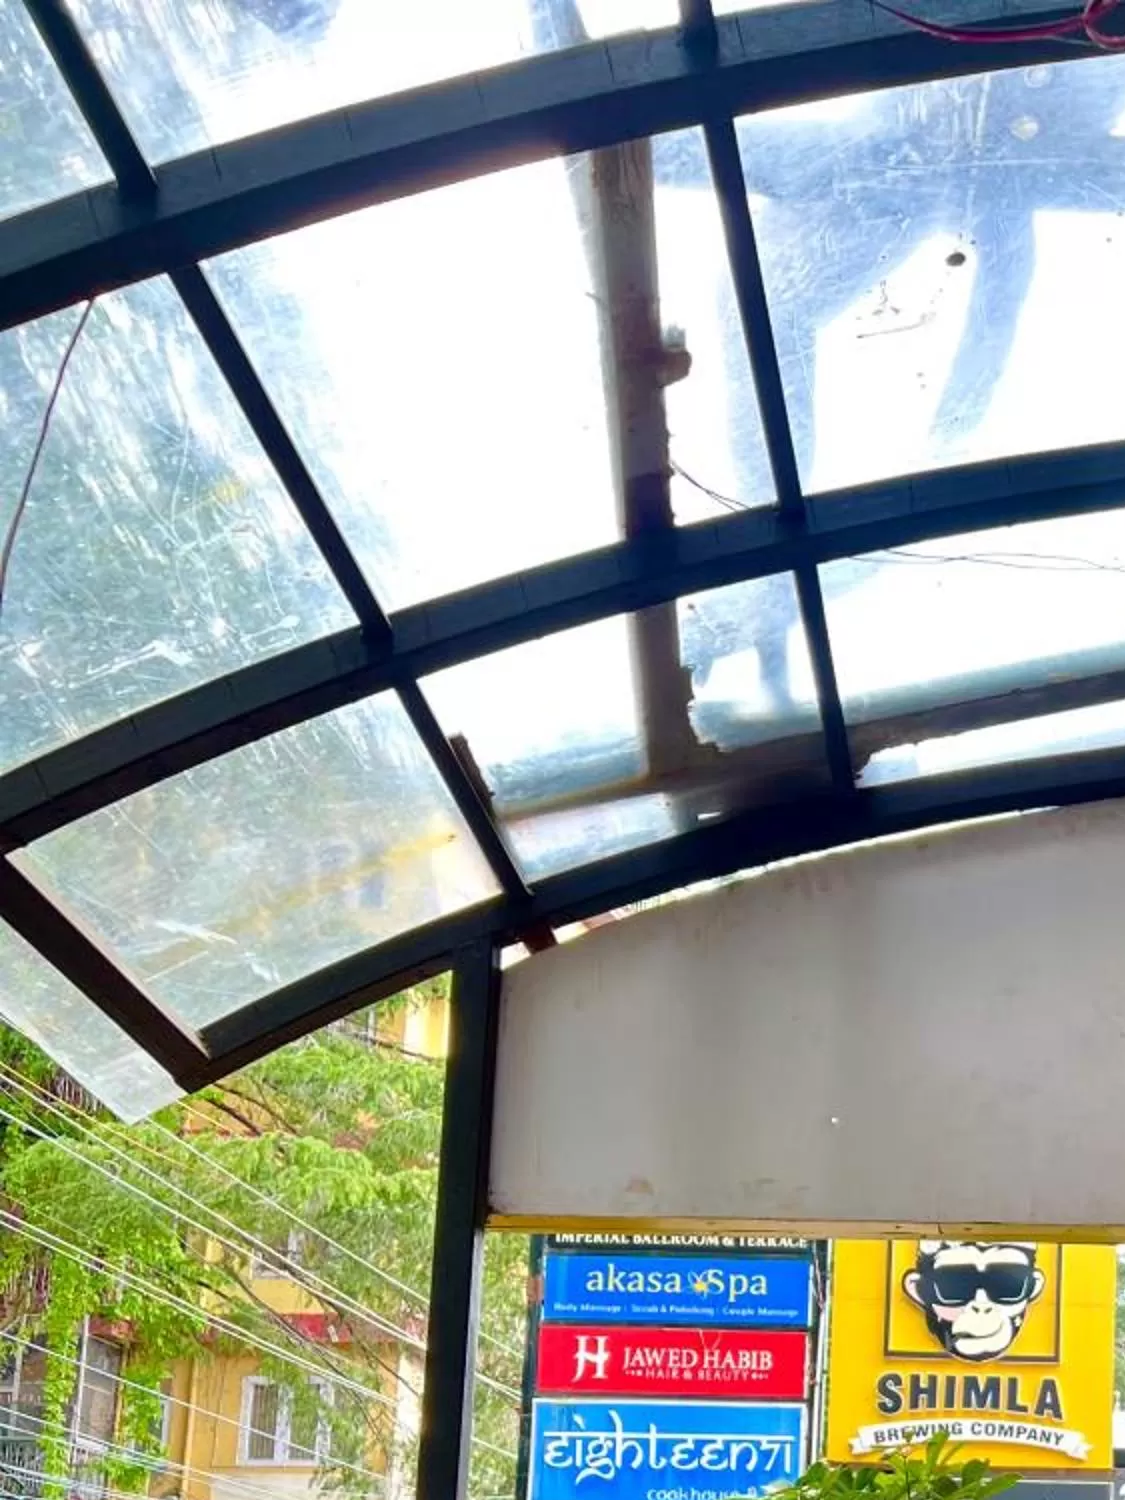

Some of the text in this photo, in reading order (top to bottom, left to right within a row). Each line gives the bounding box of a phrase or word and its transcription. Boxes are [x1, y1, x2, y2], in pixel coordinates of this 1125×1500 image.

[585, 1263, 768, 1303] akasa Spa
[622, 1346, 774, 1371] JAWED HABIB
[876, 1371, 1064, 1421] SHIMLA
[970, 1421, 1065, 1446] COMPANY
